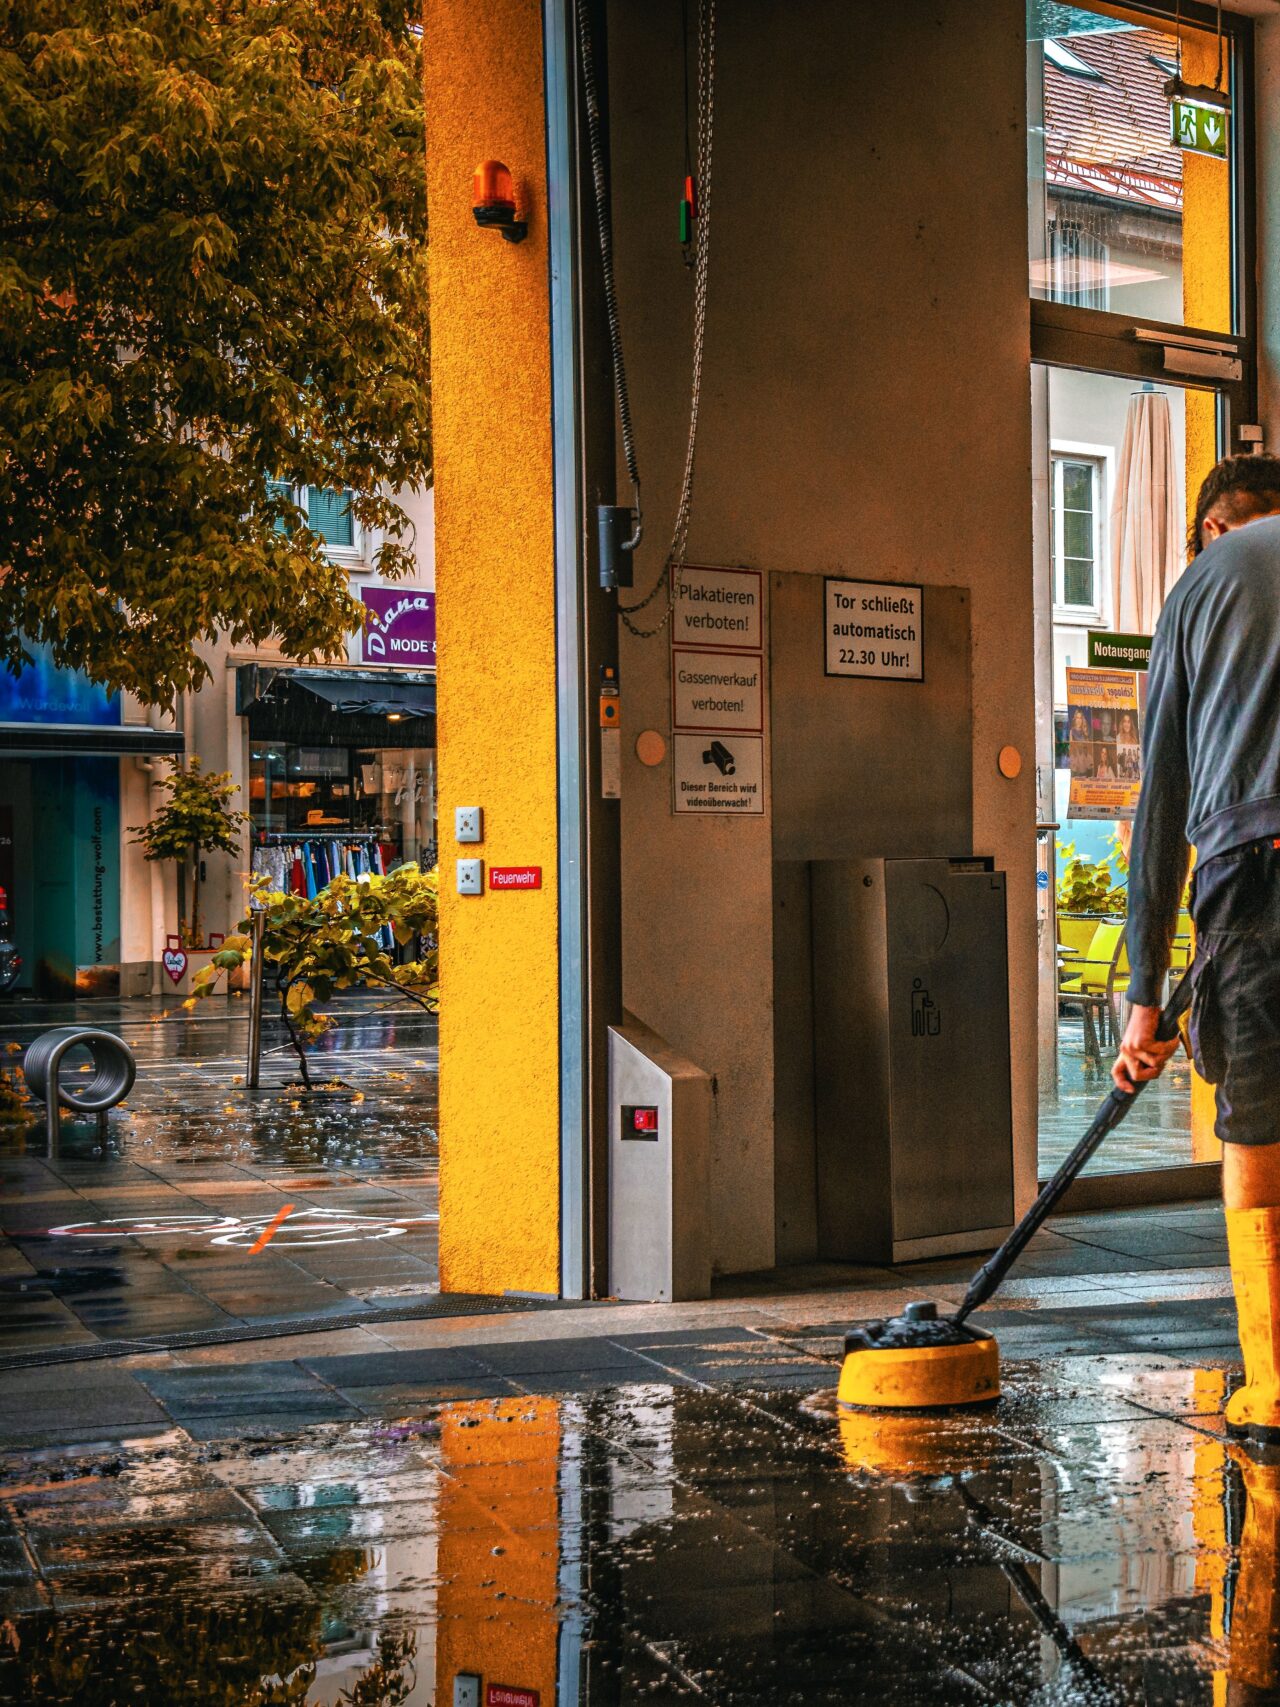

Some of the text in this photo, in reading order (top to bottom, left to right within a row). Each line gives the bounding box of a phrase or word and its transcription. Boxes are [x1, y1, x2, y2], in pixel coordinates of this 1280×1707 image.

[679, 584, 755, 605] Plakatieren
[834, 593, 914, 614] Tor schließt
[367, 597, 429, 656] Diana
[685, 612, 749, 631] verboten!
[833, 622, 916, 641] automatisch
[390, 638, 428, 652] MODE
[1094, 641, 1151, 662] Notausgang
[839, 649, 910, 668] 22.30 Uhr!
[678, 670, 758, 687] Gassenverkauf
[692, 697, 744, 712] verboten!
[681, 782, 757, 793] Dieser Bereich wird
[686, 796, 752, 807] videoüberwacht!
[92, 806, 105, 962] www.bestattung-wolf.com
[492, 871, 536, 885] Feuerwehr
